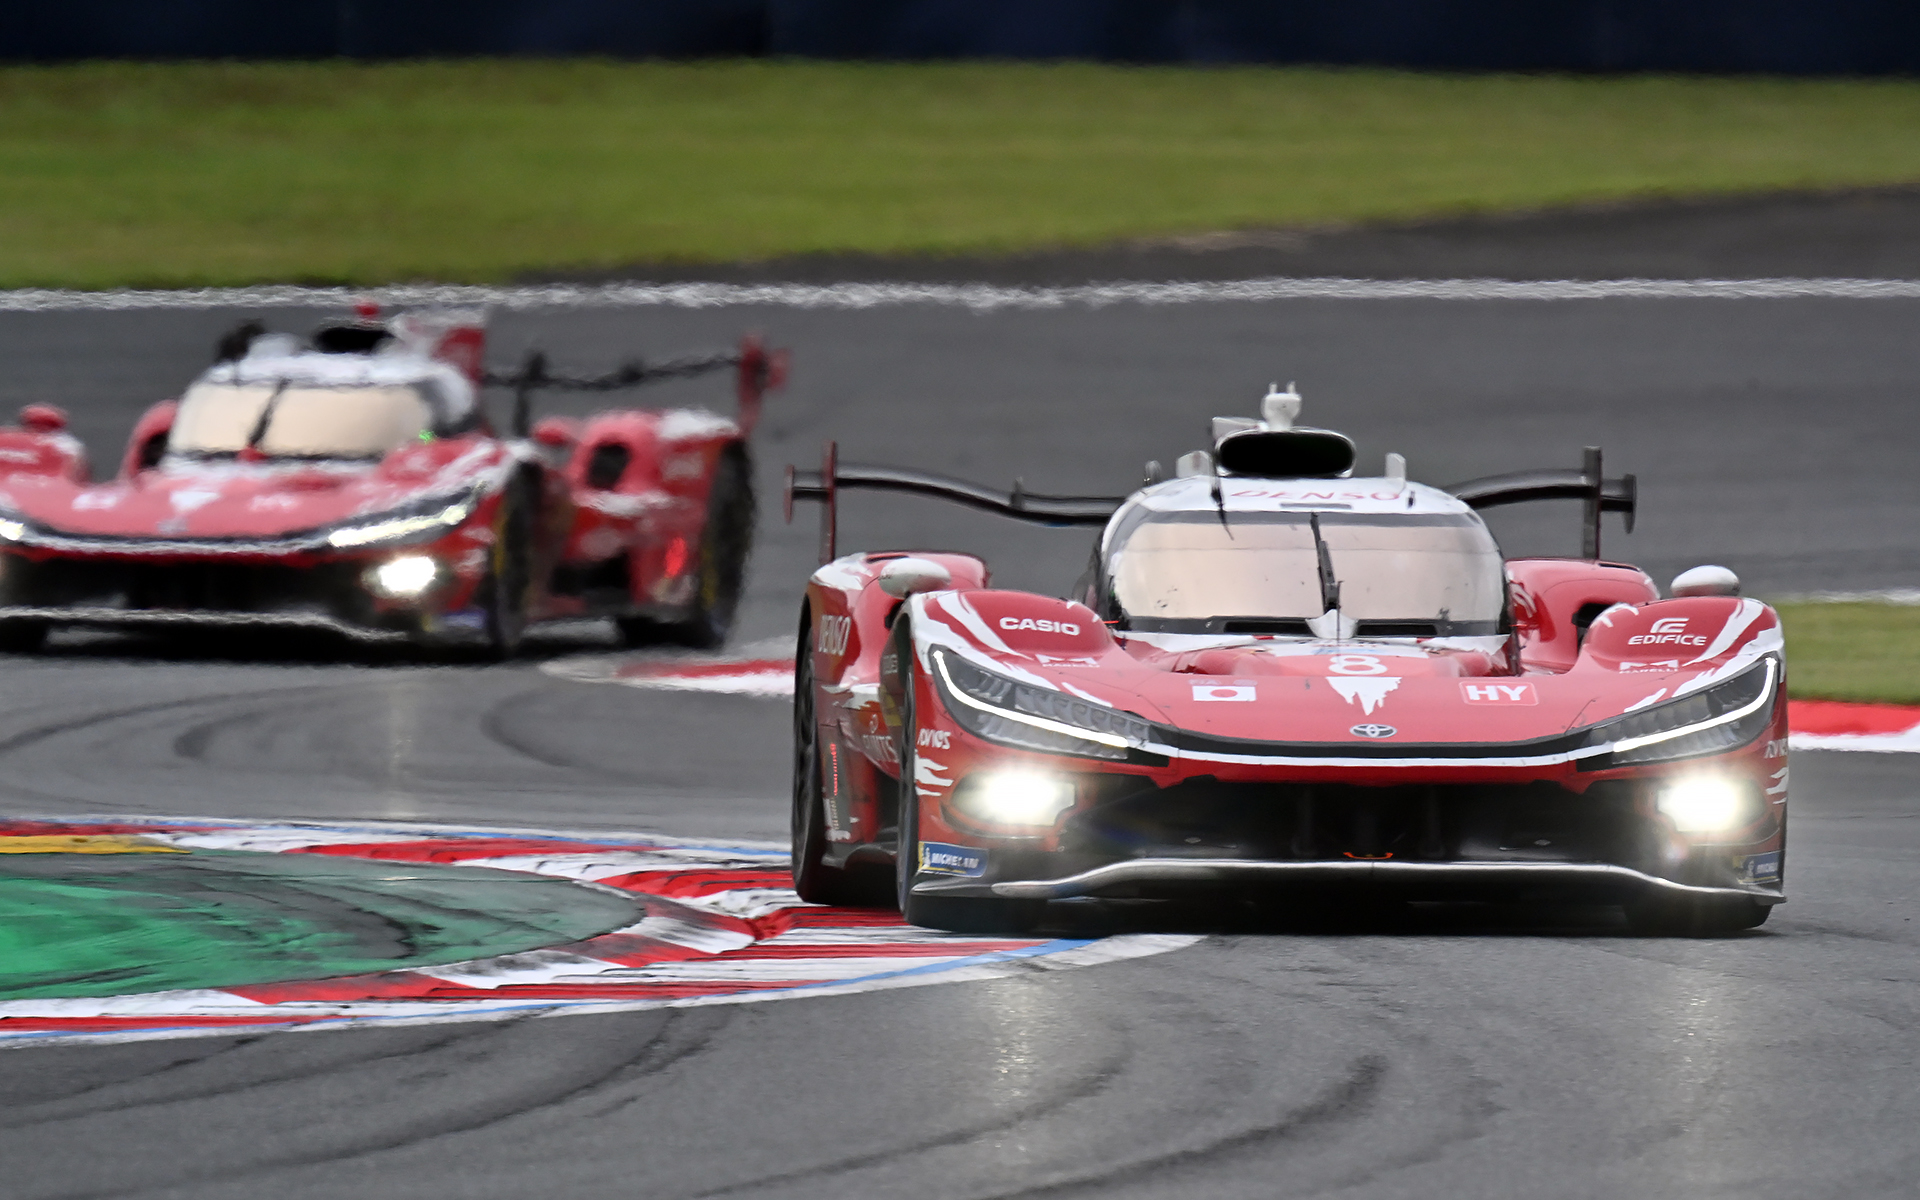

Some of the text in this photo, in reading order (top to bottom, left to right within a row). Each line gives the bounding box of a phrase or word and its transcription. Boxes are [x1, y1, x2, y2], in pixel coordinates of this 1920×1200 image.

[1230, 489, 1400, 501] DENSO
[999, 616, 1081, 636] CASIO
[1627, 633, 1708, 646] EDIFICE
[1328, 654, 1388, 676] 8
[1465, 685, 1528, 701] HY
